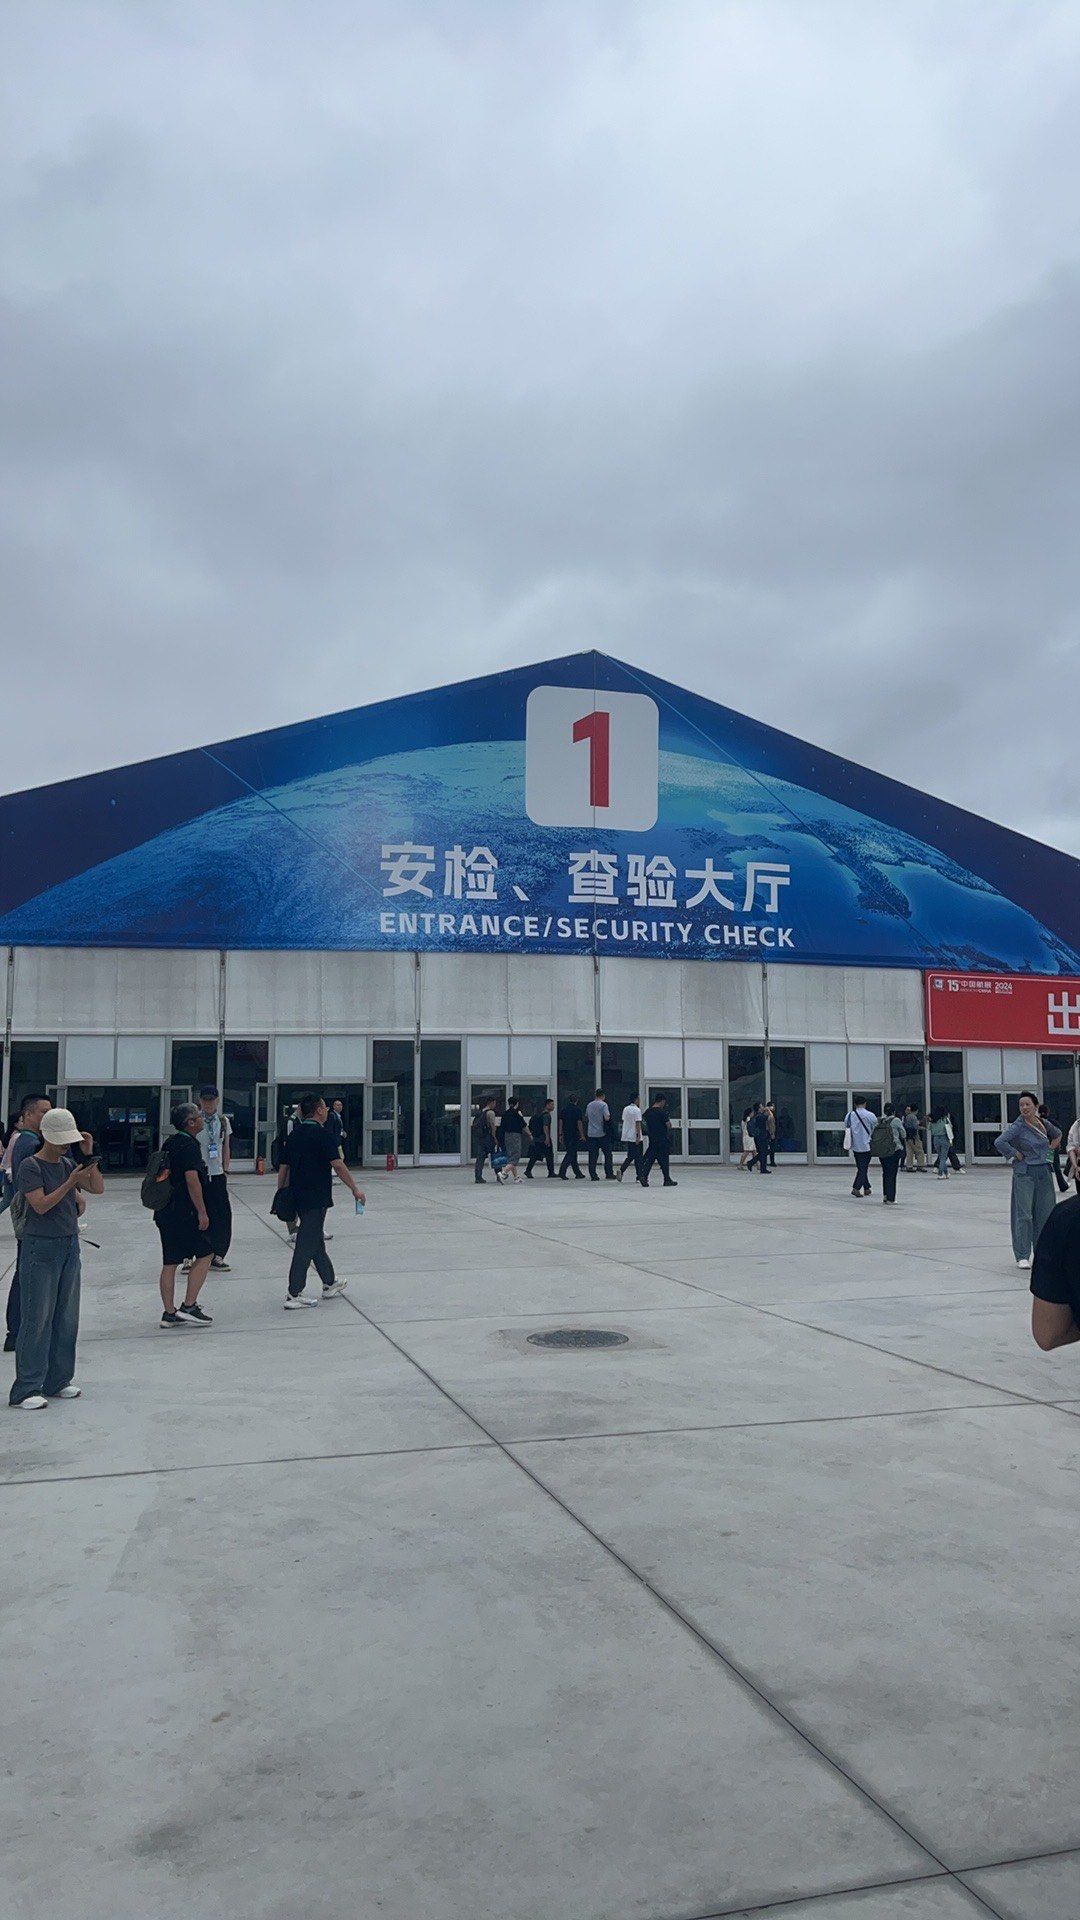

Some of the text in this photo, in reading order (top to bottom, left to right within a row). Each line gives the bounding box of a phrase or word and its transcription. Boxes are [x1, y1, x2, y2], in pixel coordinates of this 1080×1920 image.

[572, 711, 610, 808] 1
[380, 841, 791, 913] 安检、查验大厅
[379, 912, 796, 948] ENTRANCE/SECURITY CHECK
[947, 979, 960, 992] 15
[994, 981, 1013, 991] 2024
[1047, 991, 1080, 1036] 出
